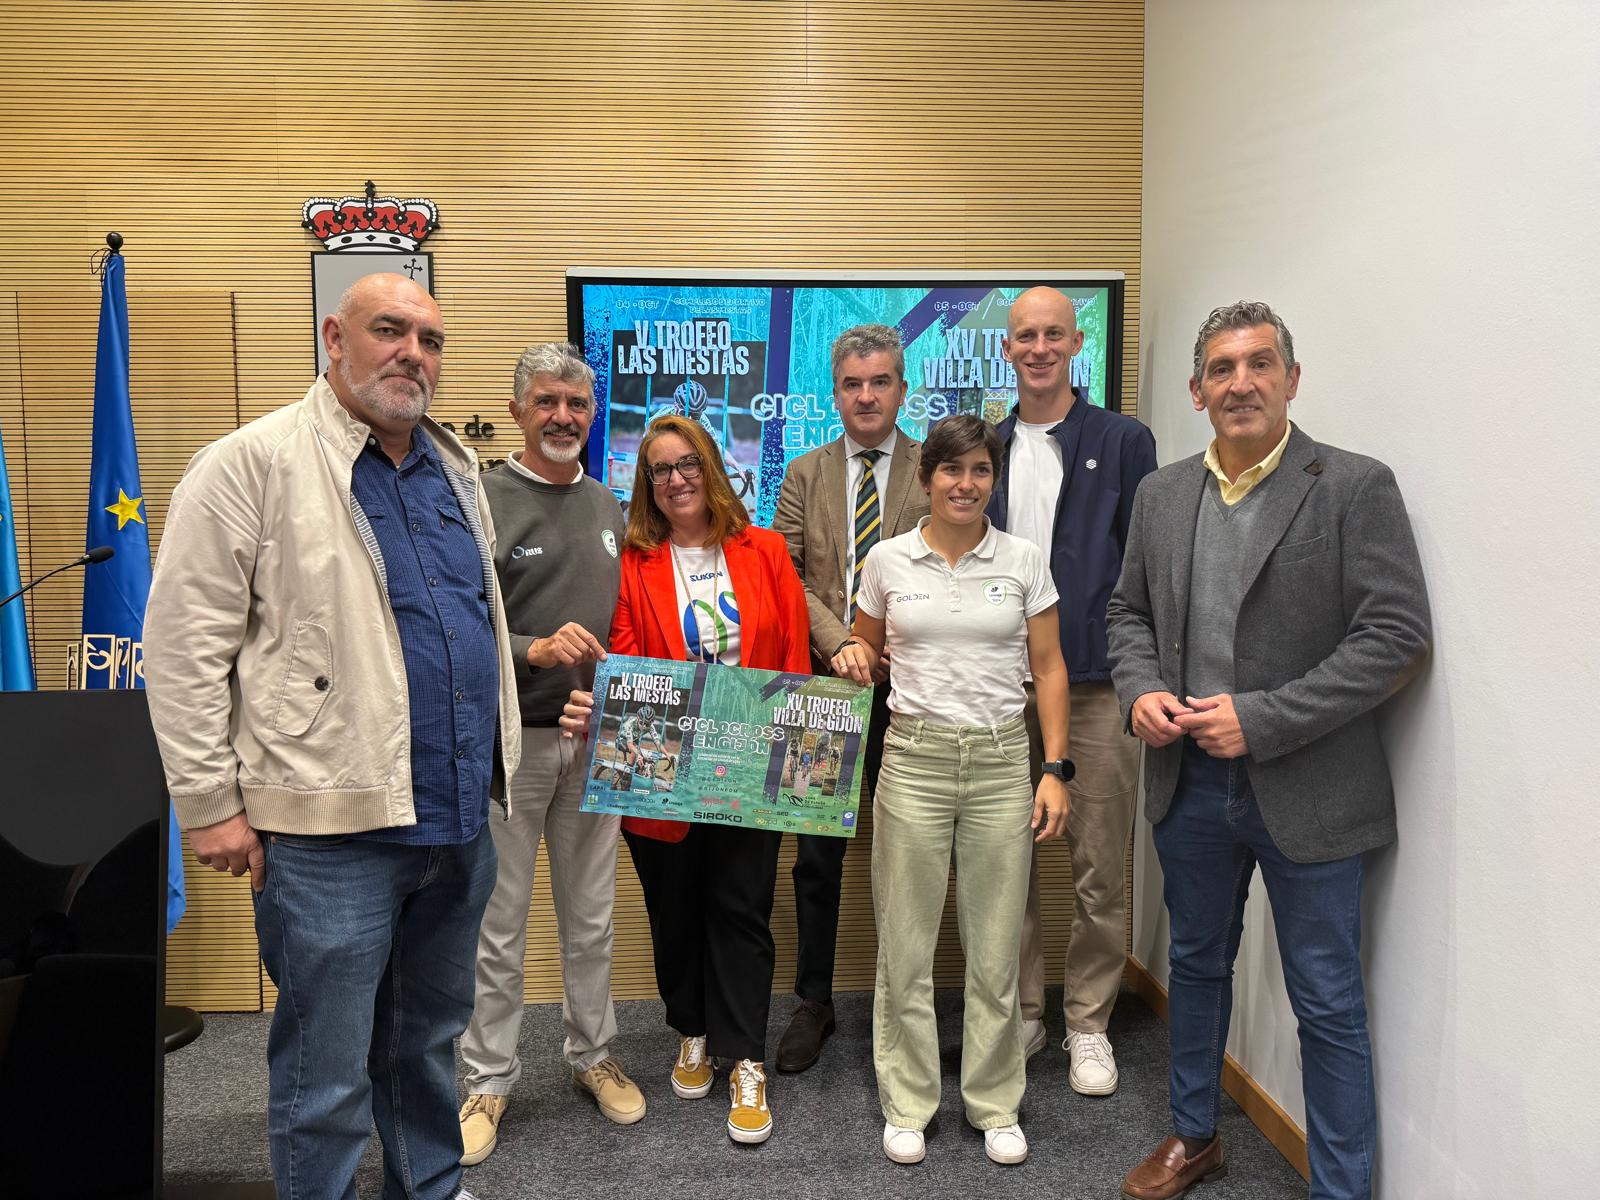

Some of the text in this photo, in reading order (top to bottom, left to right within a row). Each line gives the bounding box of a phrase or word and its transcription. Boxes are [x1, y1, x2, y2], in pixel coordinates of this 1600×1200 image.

[934, 301, 950, 311] 05
[957, 301, 981, 312] OCT
[634, 319, 732, 351] V TROFEO
[945, 328, 977, 360] XV
[617, 345, 750, 376] LAS MESTAS
[923, 357, 984, 389] VILLA
[464, 414, 496, 438] de
[896, 593, 930, 603] GOLDEN
[621, 671, 673, 692] V TROFEO
[609, 684, 681, 706] LAS MESTAS
[786, 692, 852, 717] XV TROFEO
[677, 715, 785, 741] CICLOCROSS
[773, 706, 806, 728] VILLA
[808, 711, 824, 730] DE
[693, 734, 716, 749] EN
[693, 811, 743, 823] SIROKO
